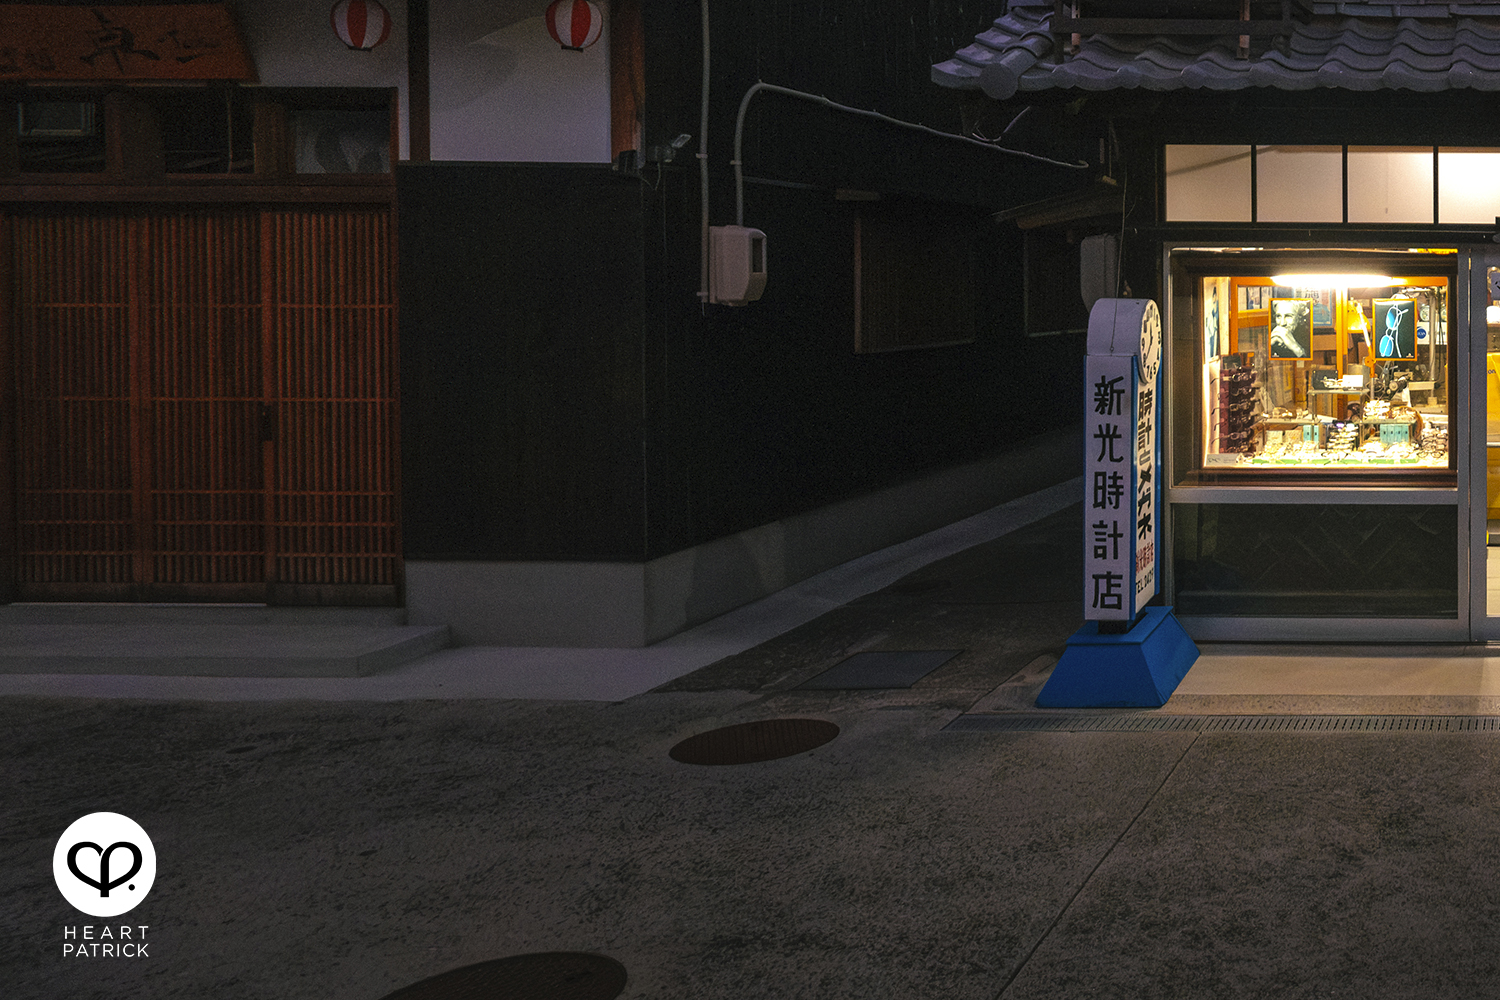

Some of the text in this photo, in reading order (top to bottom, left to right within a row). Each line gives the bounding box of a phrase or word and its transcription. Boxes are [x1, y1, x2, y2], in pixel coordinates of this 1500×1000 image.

[1092, 375, 1125, 610] 新光時計店
